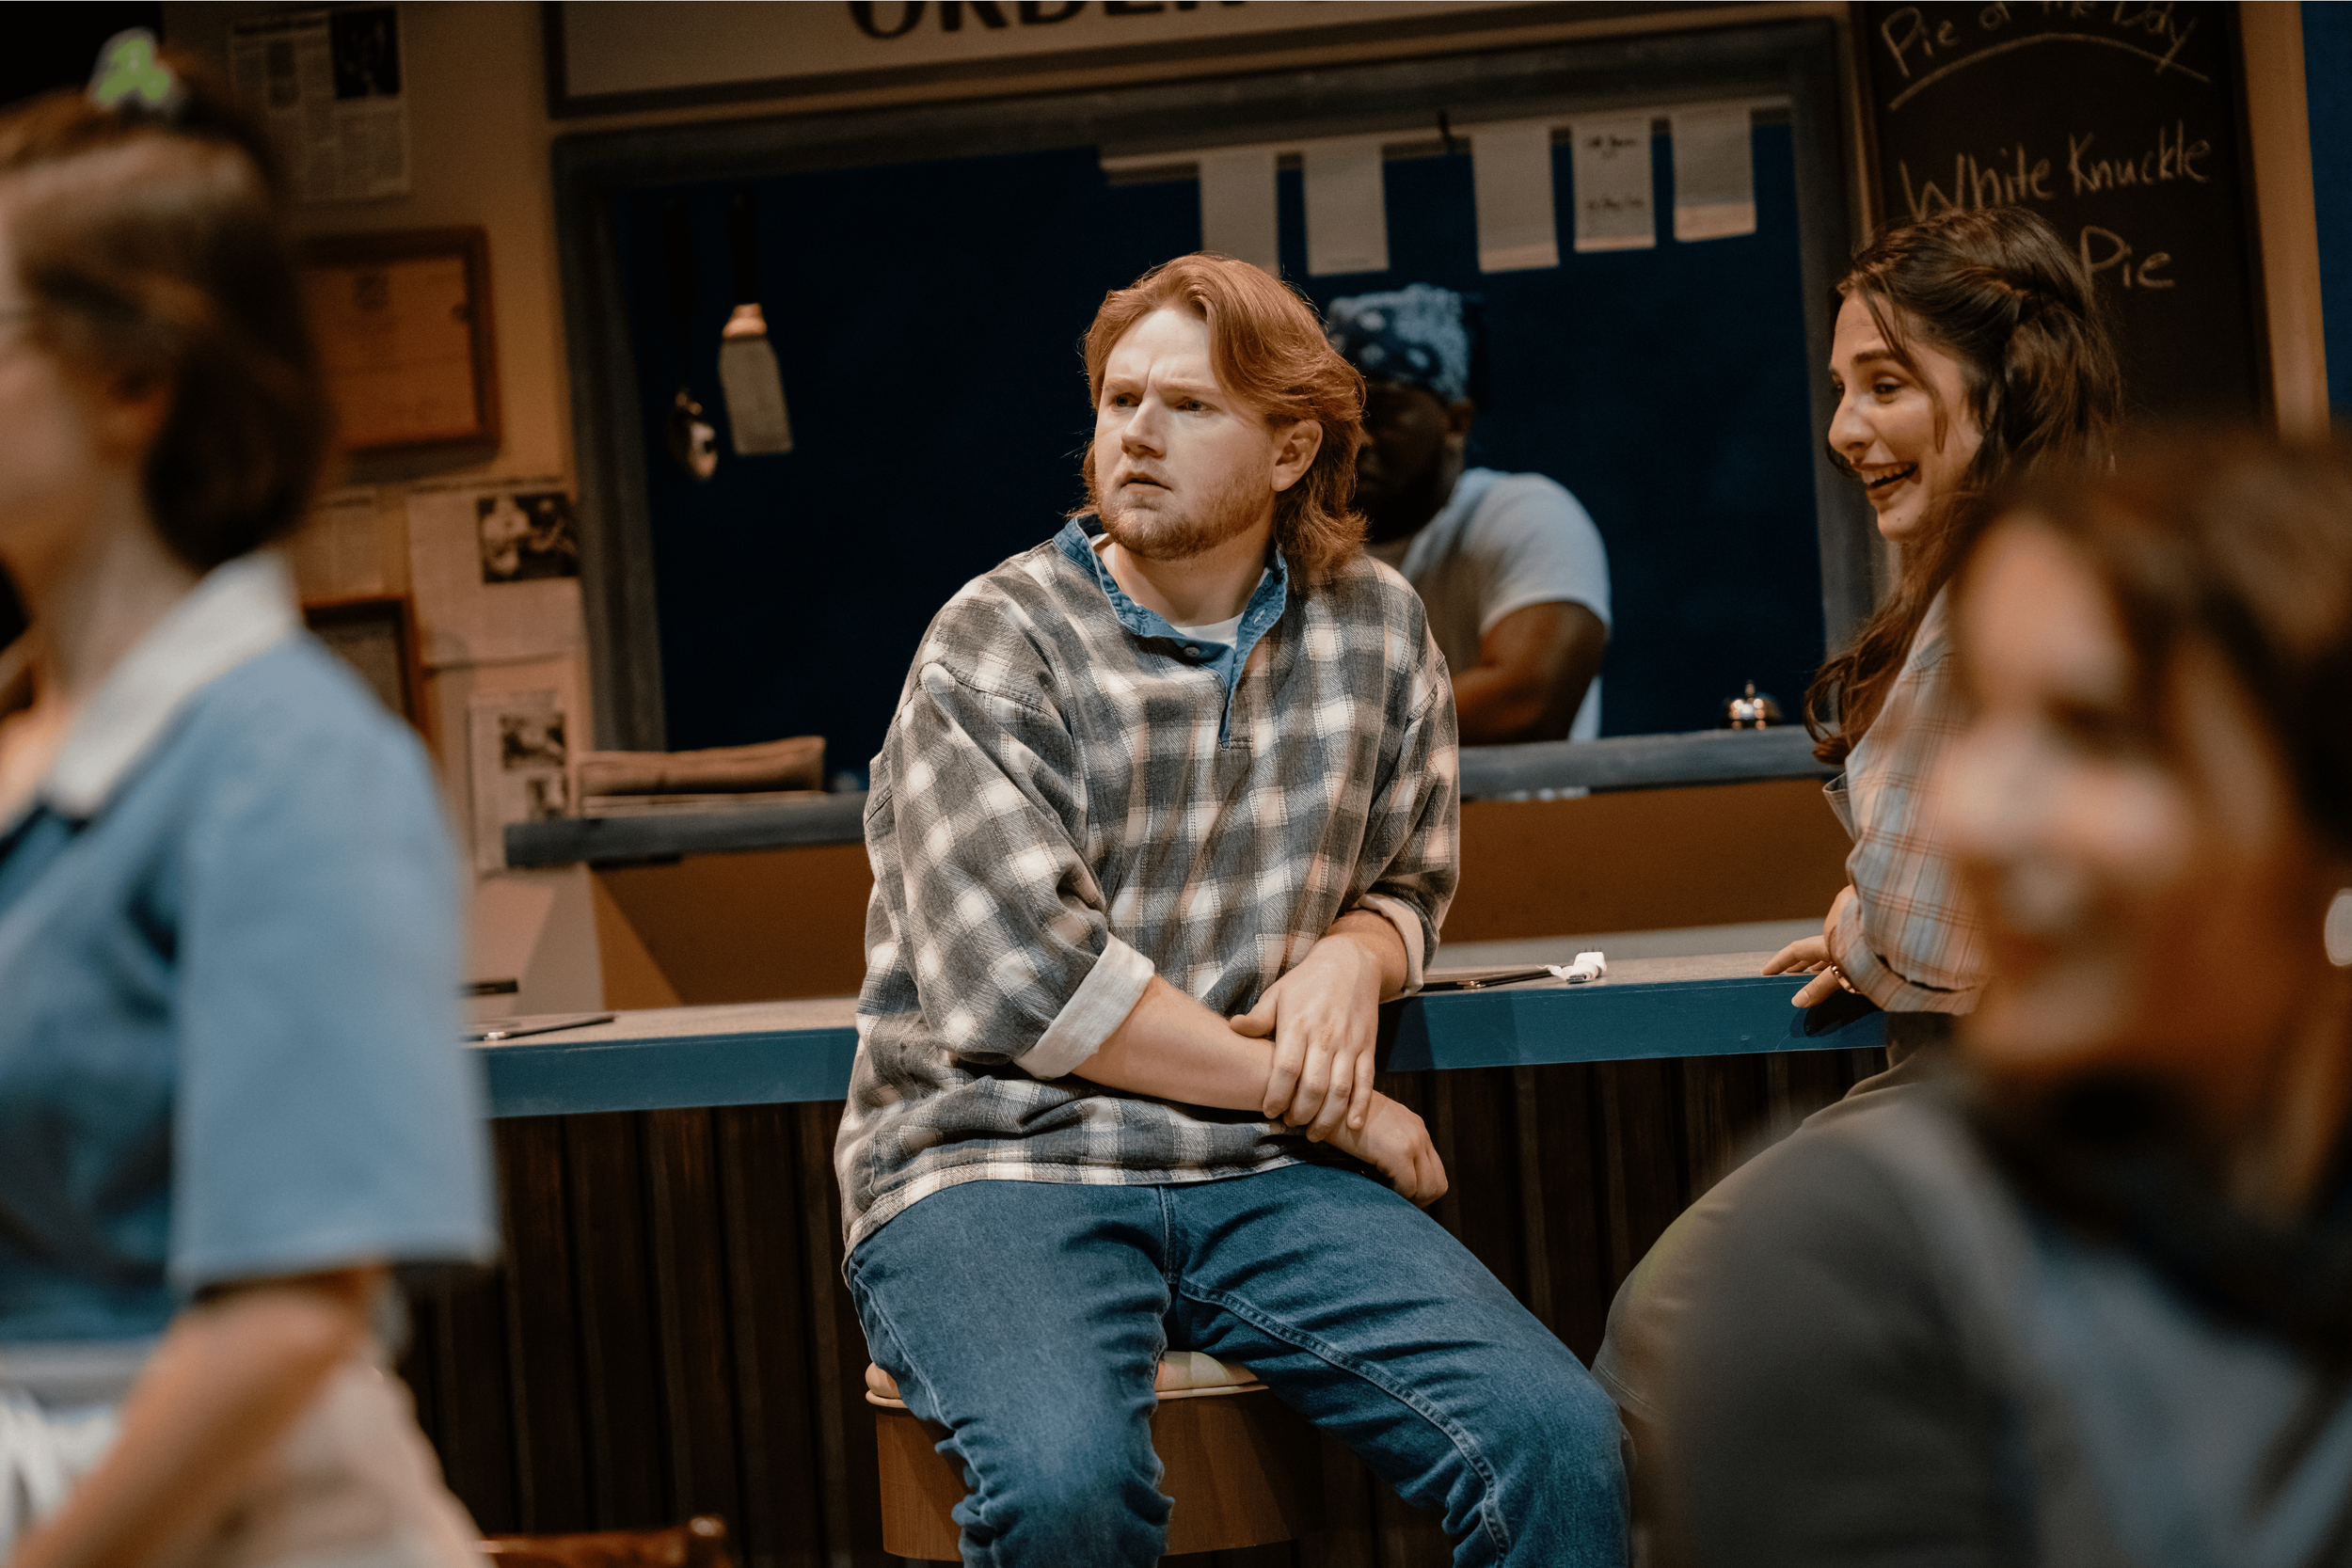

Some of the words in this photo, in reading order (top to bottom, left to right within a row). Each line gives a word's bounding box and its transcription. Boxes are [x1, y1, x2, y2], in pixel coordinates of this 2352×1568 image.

[1882, 7, 1961, 78] Pie
[1899, 142, 2055, 223] White
[2069, 119, 2212, 197] Knuckle
[2079, 225, 2175, 290] Pie
